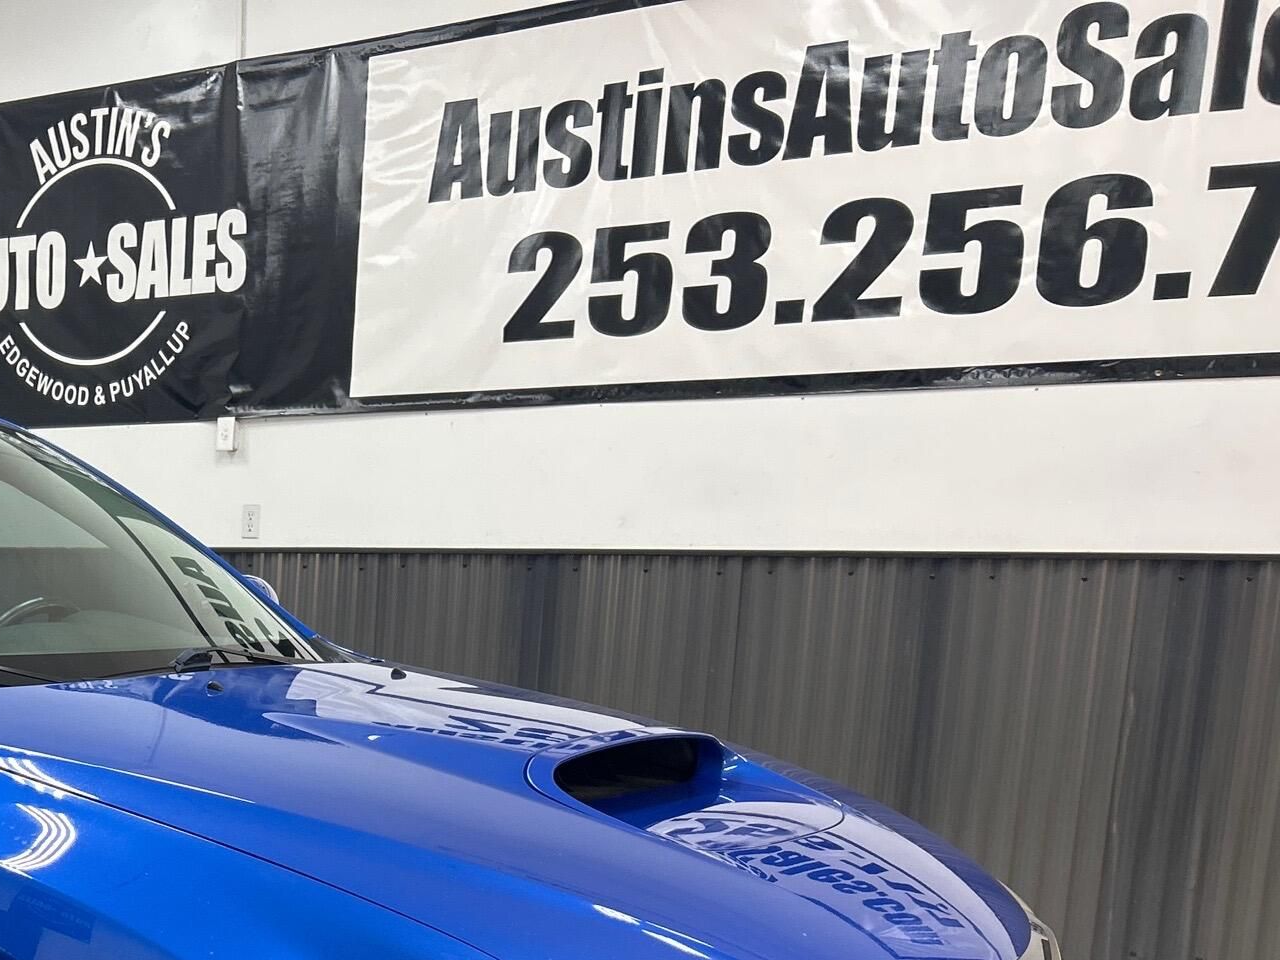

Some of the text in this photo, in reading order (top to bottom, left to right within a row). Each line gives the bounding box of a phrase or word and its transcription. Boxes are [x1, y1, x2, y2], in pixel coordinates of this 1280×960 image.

[29, 106, 171, 186] AUSTIN'S
[106, 208, 248, 303] SALES
[93, 384, 107, 406] &
[108, 321, 191, 403] PUYALLUP
